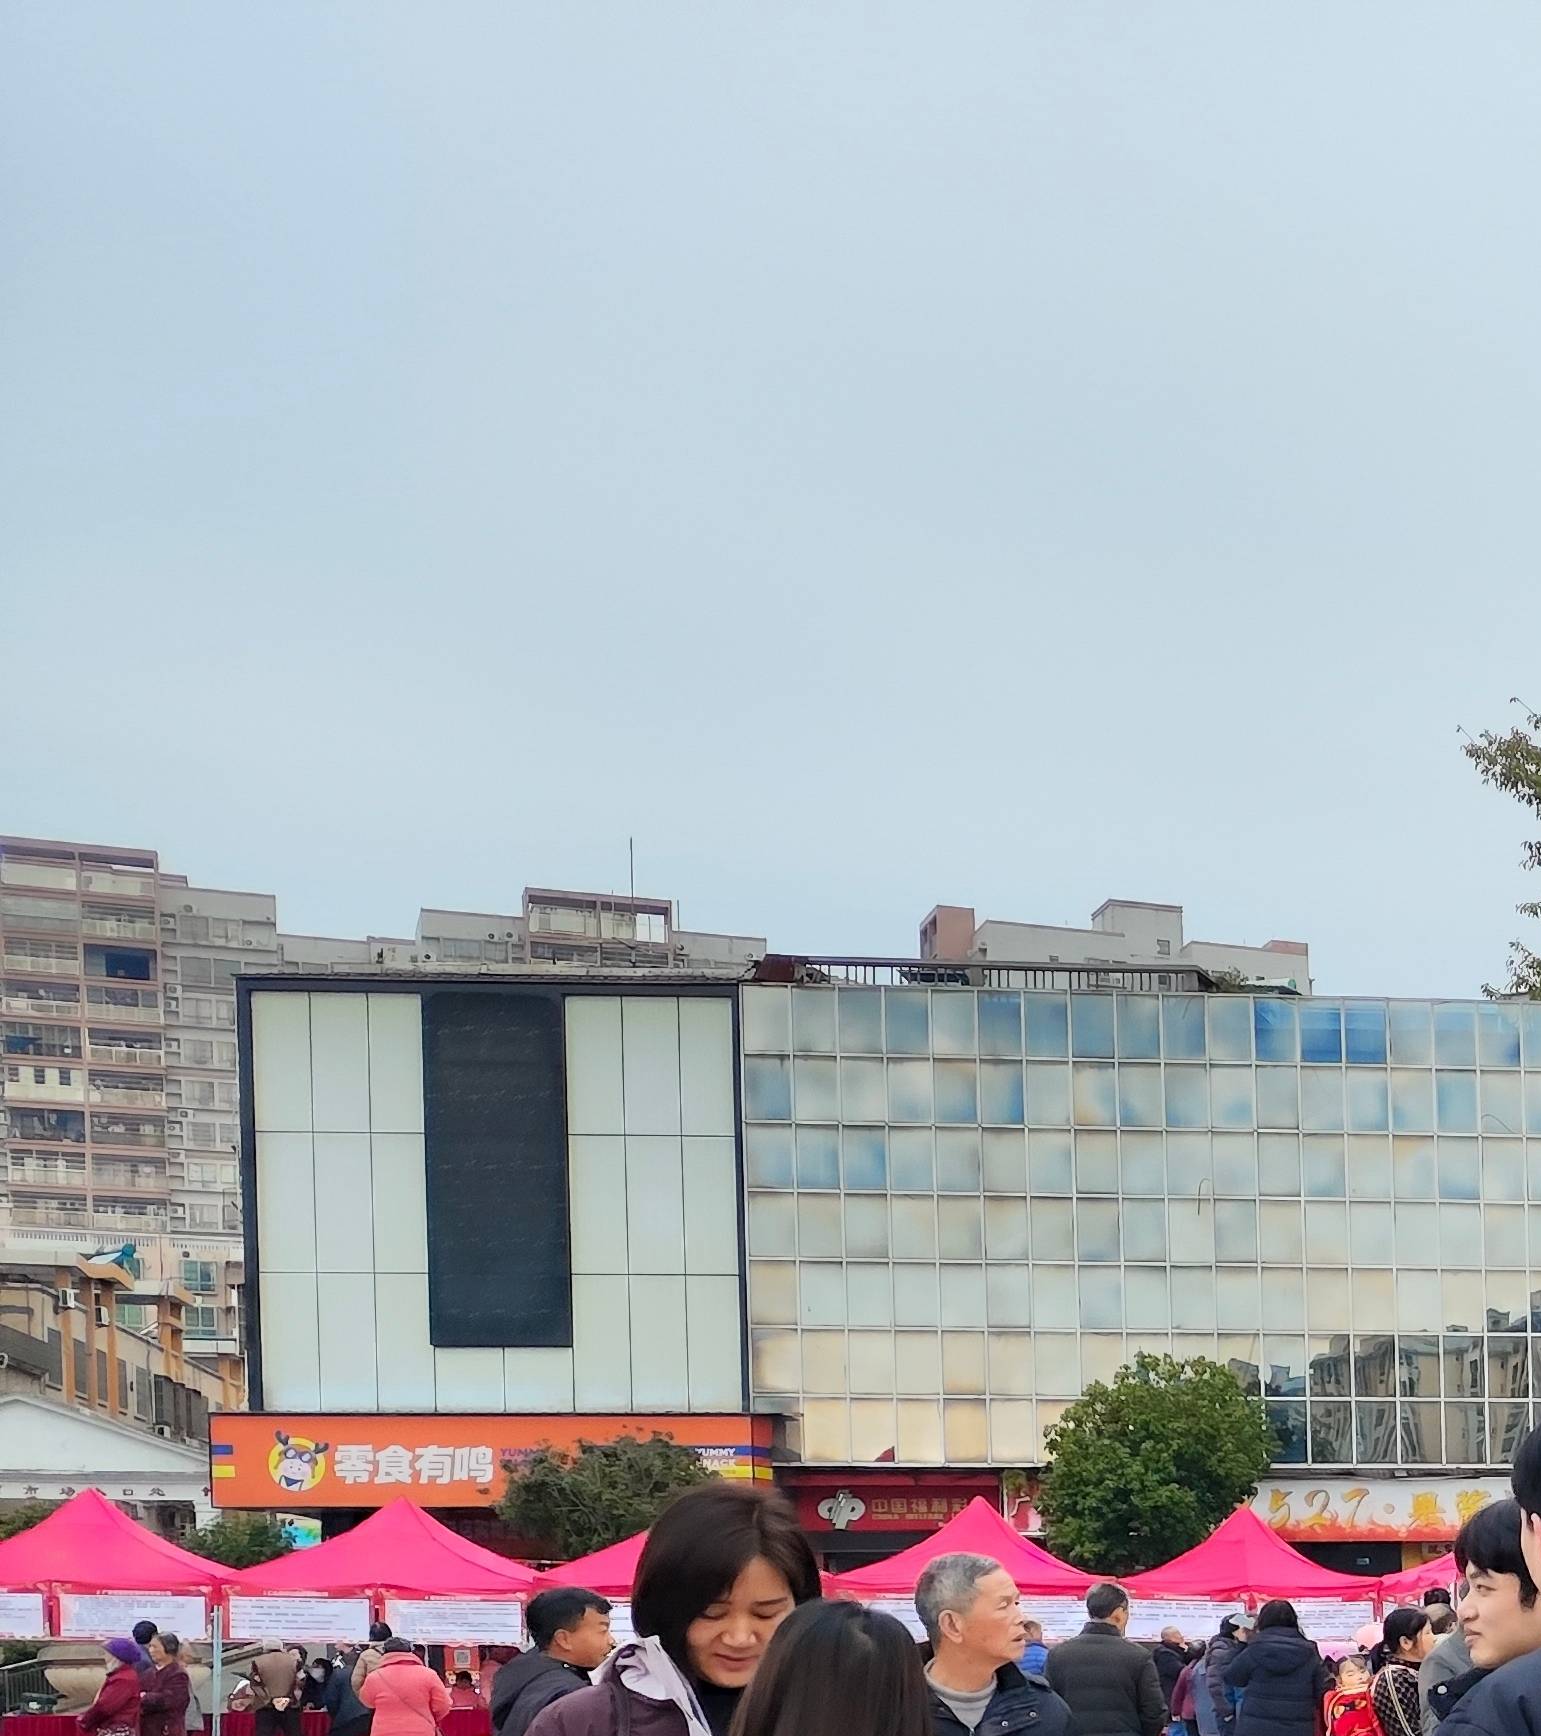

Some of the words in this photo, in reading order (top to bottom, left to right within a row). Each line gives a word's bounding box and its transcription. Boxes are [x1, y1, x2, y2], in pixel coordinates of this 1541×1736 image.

[334, 1443, 493, 1485] 零食有鸣
[694, 1447, 736, 1457] YUMMY
